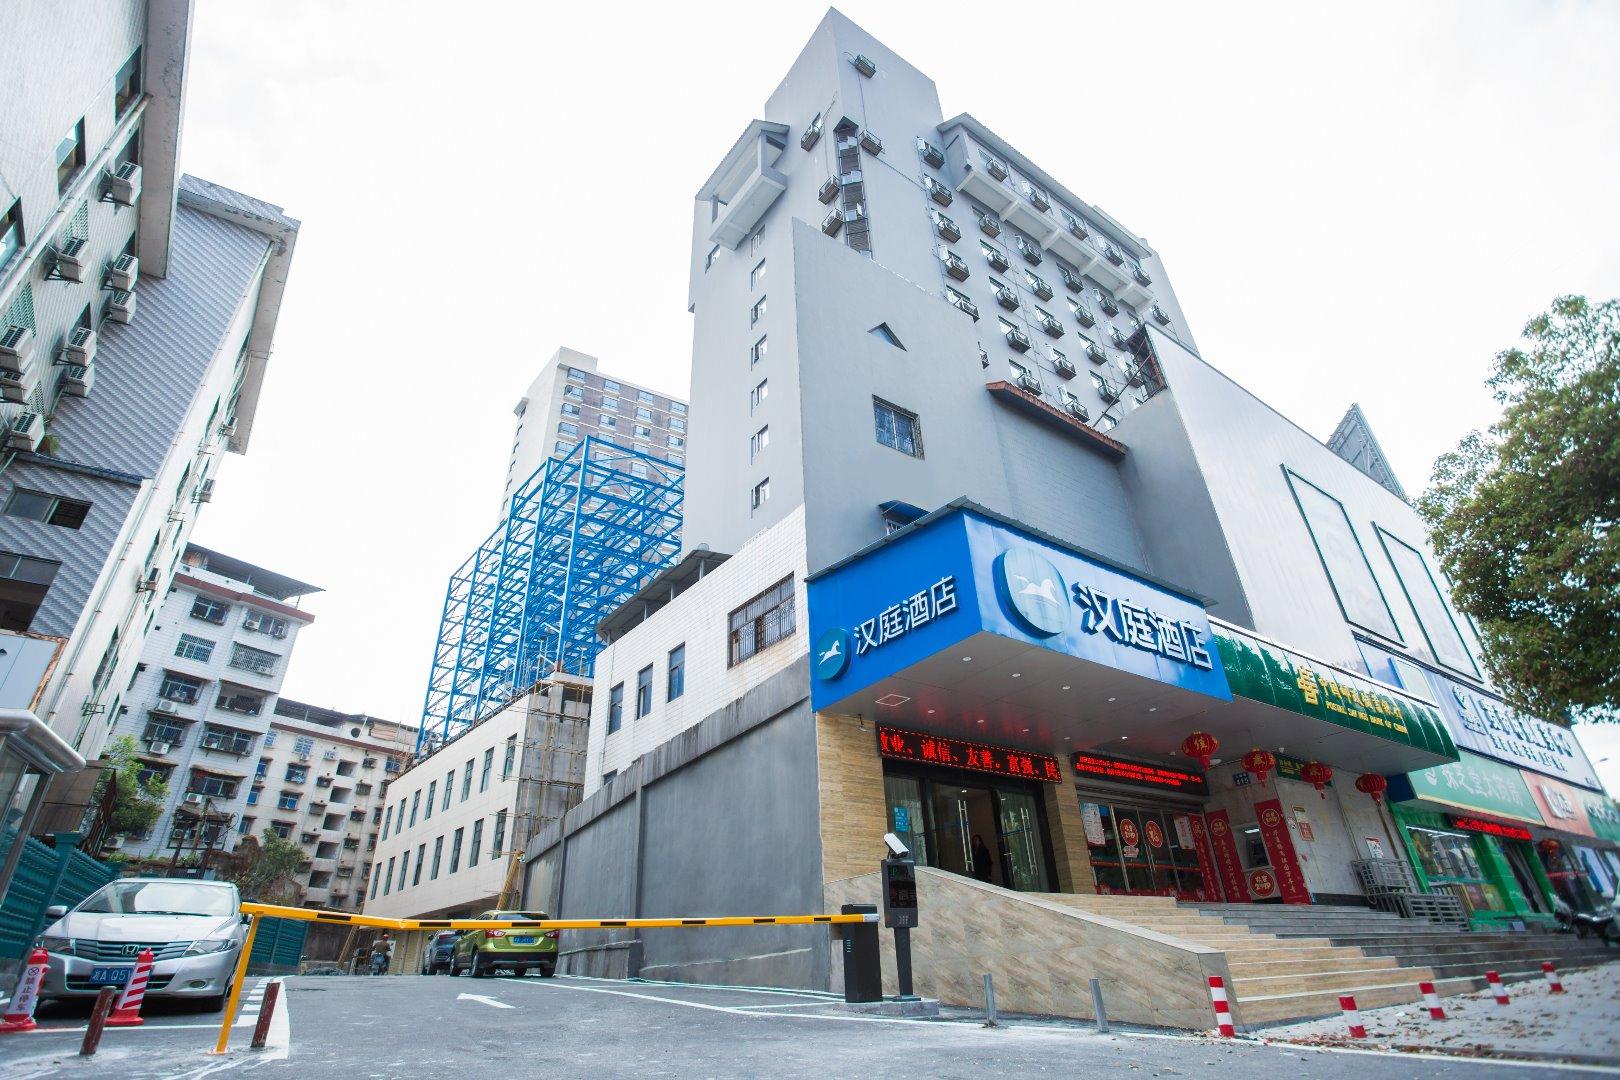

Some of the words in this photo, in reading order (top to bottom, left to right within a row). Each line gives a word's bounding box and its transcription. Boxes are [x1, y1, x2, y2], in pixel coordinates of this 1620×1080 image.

[853, 574, 958, 656] 汉庭酒店
[1074, 582, 1213, 671] 汉庭酒店
